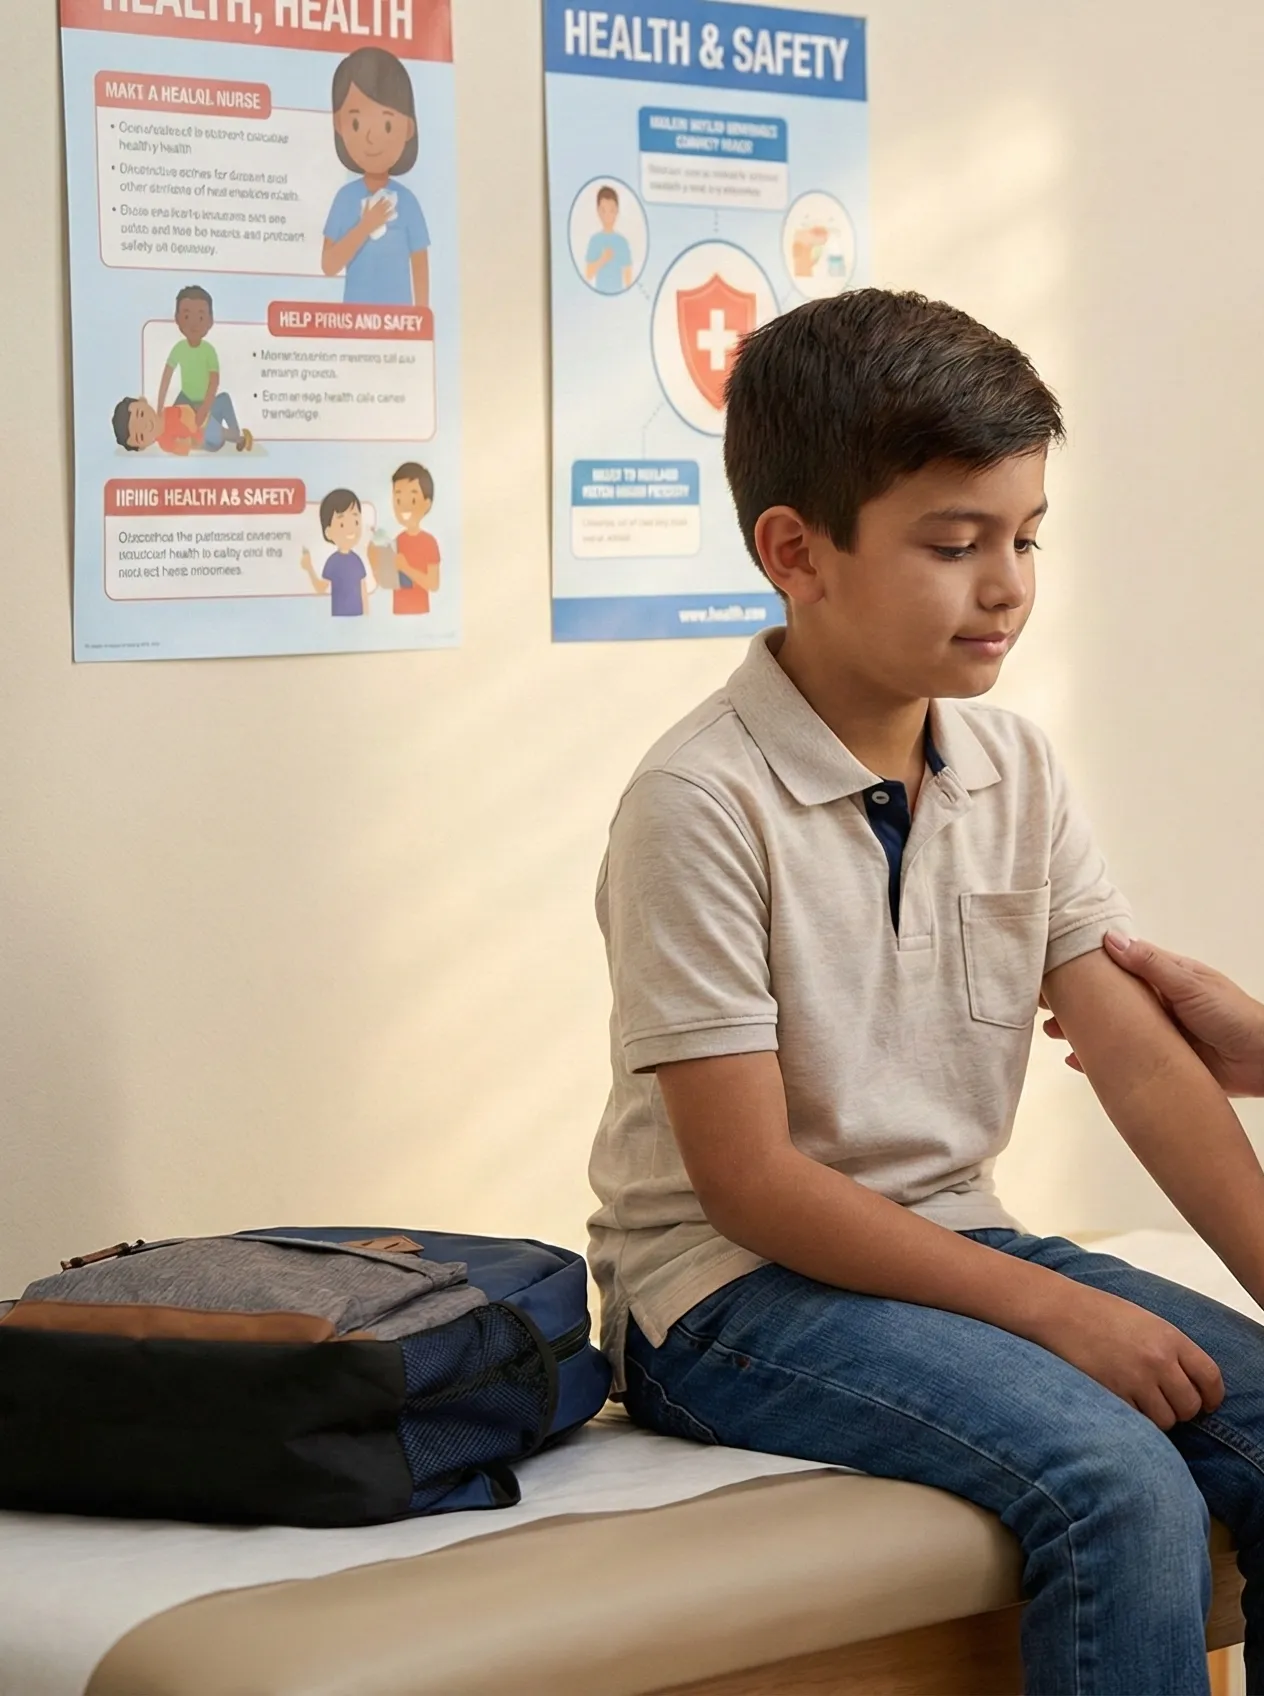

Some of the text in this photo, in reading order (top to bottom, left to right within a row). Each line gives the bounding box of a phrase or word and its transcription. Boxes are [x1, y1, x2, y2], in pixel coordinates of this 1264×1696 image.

[564, 9, 849, 81] HEALTH & SAFETY
[148, 85, 159, 101] A
[216, 90, 262, 109] NURSE
[279, 311, 311, 328] HELP
[355, 314, 382, 331] AND
[164, 488, 216, 506] HEALTH
[244, 487, 295, 506] SAFETY
